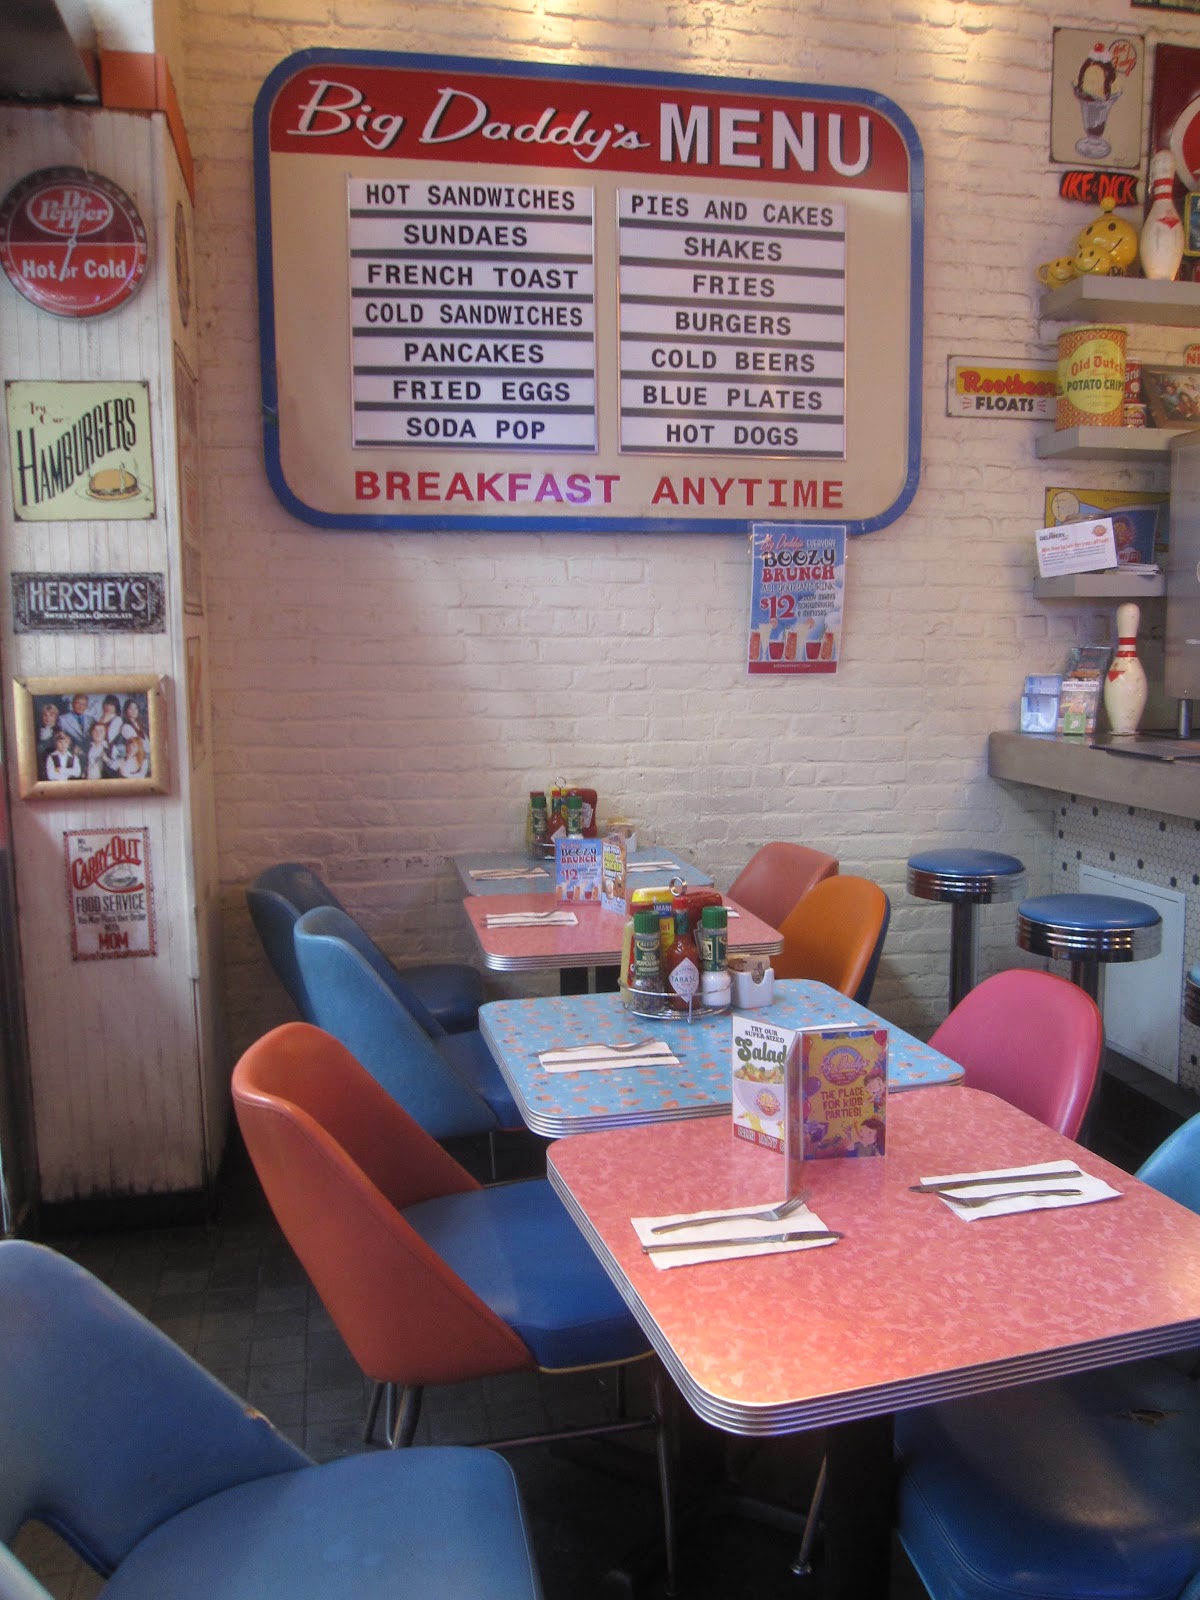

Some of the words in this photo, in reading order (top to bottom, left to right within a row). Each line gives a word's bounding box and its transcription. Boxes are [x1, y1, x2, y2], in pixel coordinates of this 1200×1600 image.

[286, 79, 404, 151] Big
[419, 86, 651, 162] Daddy's
[659, 101, 874, 177] MENU
[62, 190, 92, 209] Dr
[366, 184, 411, 205] HOT
[427, 185, 576, 211] SANDWICHES
[1060, 171, 1095, 201] IKE
[1098, 174, 1138, 205] DICK
[39, 200, 109, 229] Pepper
[631, 194, 690, 218] PIES
[704, 199, 748, 221] AND
[763, 203, 834, 227] CAKES
[403, 224, 528, 247] SUNDAES
[684, 236, 783, 262] SHAKES
[22, 259, 57, 279] Hot
[84, 258, 127, 279] Cold
[367, 264, 473, 286] FRENCH
[493, 267, 579, 290] TOAST
[693, 274, 776, 298] FRIES
[365, 303, 424, 324] COLD
[439, 304, 583, 327] SANDWICHES
[675, 311, 792, 336] BURGERS
[404, 343, 545, 364] PANCAKES
[651, 348, 717, 370] COLD
[735, 351, 815, 373] BEERS
[1071, 357, 1091, 376] Old
[393, 380, 482, 401] FRIED
[501, 381, 571, 402] EGGS
[1066, 379, 1102, 392] POTATO
[643, 385, 708, 406] BLUE
[727, 388, 823, 411] PLATES
[975, 396, 1035, 413] FLOATS
[406, 417, 477, 439] SODA
[496, 419, 546, 440] POP
[666, 424, 715, 443] HOT
[734, 426, 799, 447] DOGS
[16, 397, 137, 507] HAMBURGERS
[354, 470, 621, 505] BREAKFAST
[651, 476, 844, 509] ANYTIME
[762, 549, 835, 568] BOOZY
[761, 565, 836, 583] BRUNCH
[29, 578, 147, 612] HERSHEY'S
[760, 593, 796, 619] $12
[75, 895, 101, 914] FOOD
[102, 893, 145, 912] SERVICE
[97, 931, 129, 951] MOM
[744, 1030, 785, 1044] SUPER-SIZED
[751, 1025, 763, 1033] TRY
[764, 1029, 779, 1037] OUR
[820, 1089, 836, 1101] THE
[838, 1086, 865, 1098] PLACE
[823, 1099, 840, 1110] FOR
[843, 1096, 864, 1108] KIDS
[825, 1106, 862, 1120] PARTIES!
